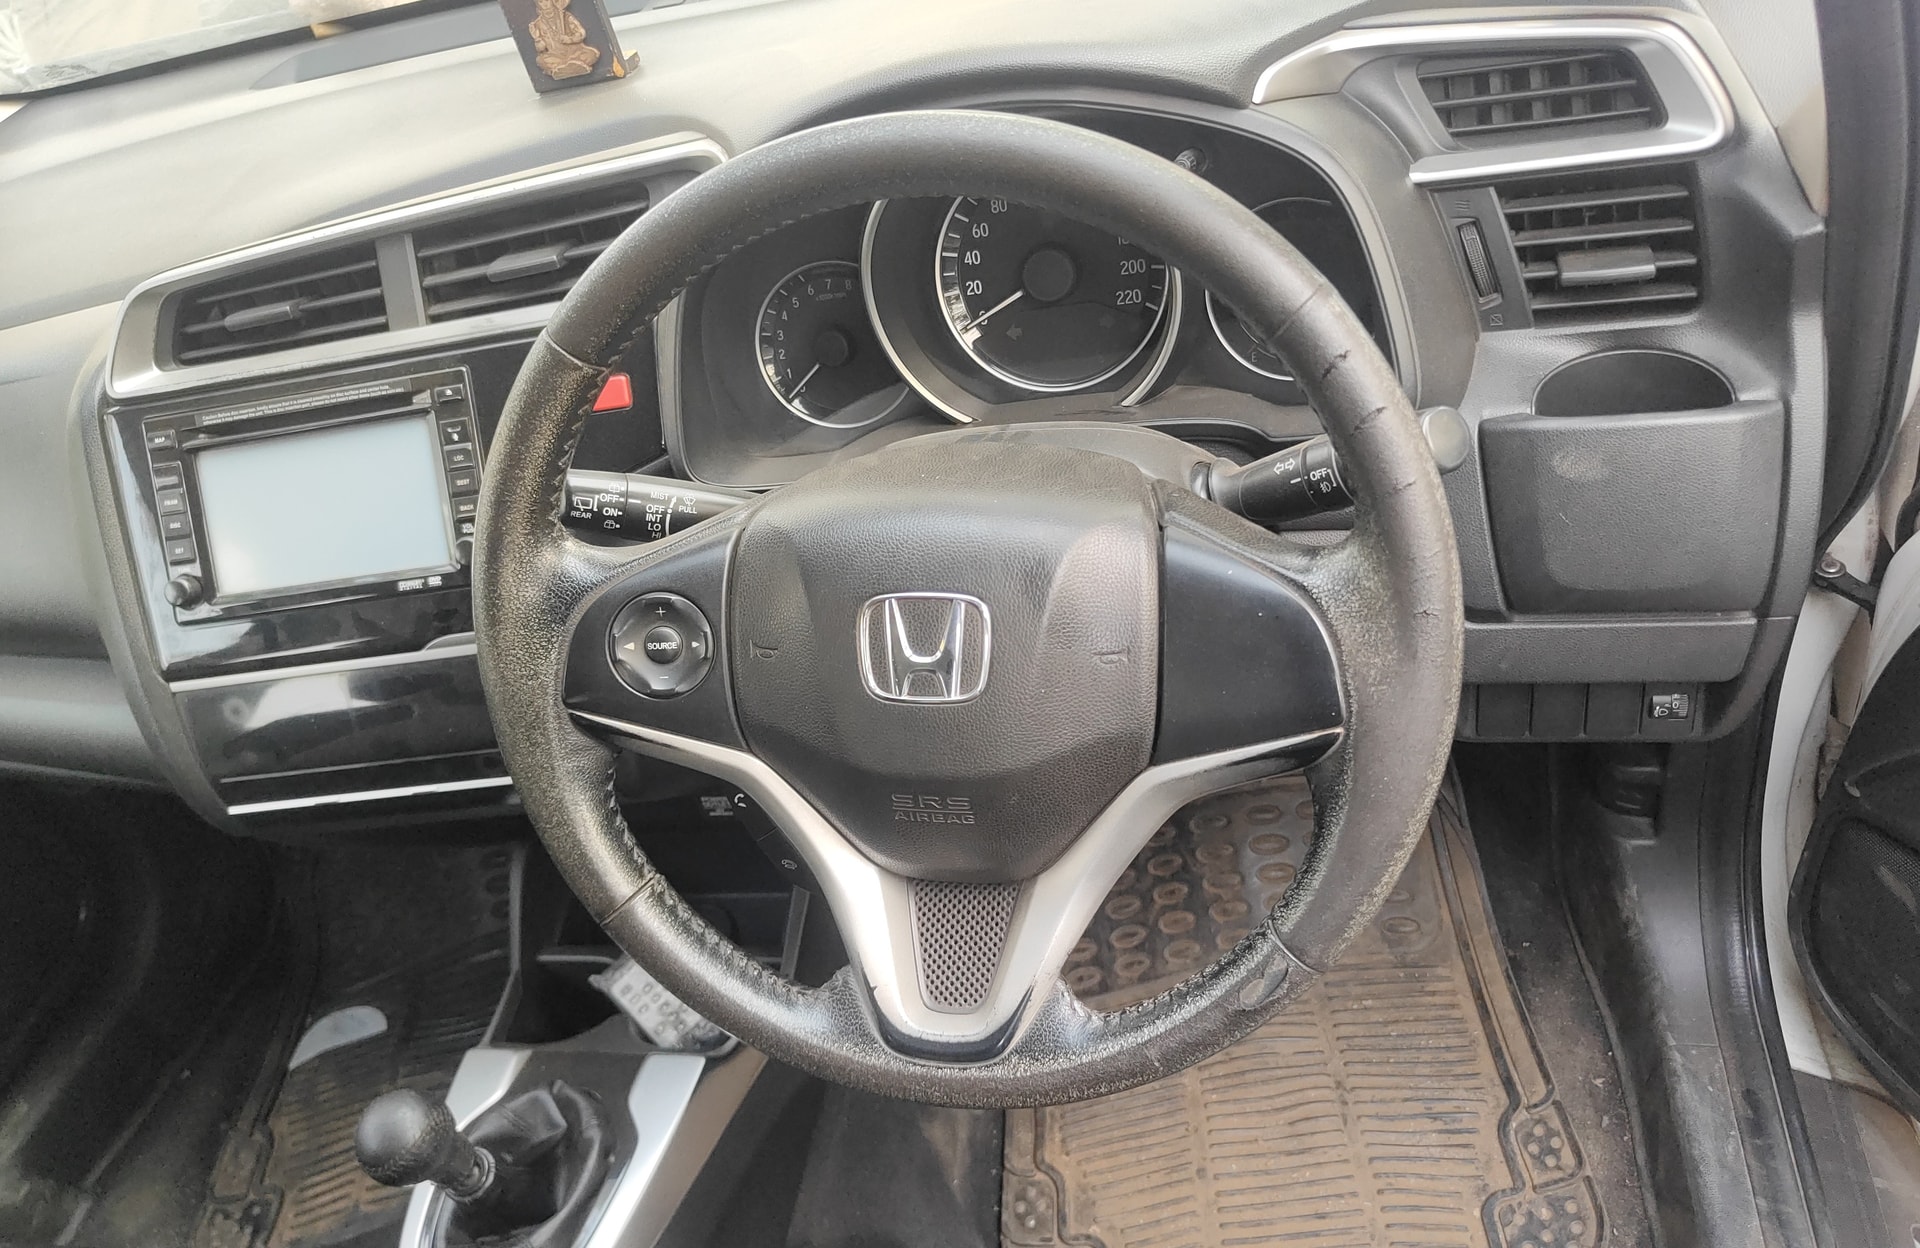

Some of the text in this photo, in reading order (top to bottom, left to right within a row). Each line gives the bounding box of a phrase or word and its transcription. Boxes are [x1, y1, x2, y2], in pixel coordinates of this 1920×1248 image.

[991, 199, 1007, 213] 80
[972, 222, 989, 238] 60
[964, 250, 981, 266] 40
[1120, 259, 1146, 275] 200
[807, 284, 814, 296] 6
[825, 279, 831, 290] 7
[965, 280, 982, 296] 20
[792, 297, 800, 308] 5
[1115, 289, 1142, 305] 220
[781, 310, 788, 321] 4
[776, 329, 784, 341] 3
[778, 349, 786, 360] 2
[786, 368, 792, 379] 1
[1310, 468, 1327, 481] OFF
[600, 493, 620, 503] OFF
[651, 491, 669, 500] MIST
[603, 507, 619, 517] ON
[646, 503, 666, 514] OFF
[678, 505, 698, 515] PULL
[570, 510, 592, 520] REAR
[645, 513, 663, 523] INT
[648, 522, 661, 531] LO
[647, 641, 678, 650] SOURCE
[891, 793, 971, 810] SRS
[894, 810, 975, 824] AIRBAG
